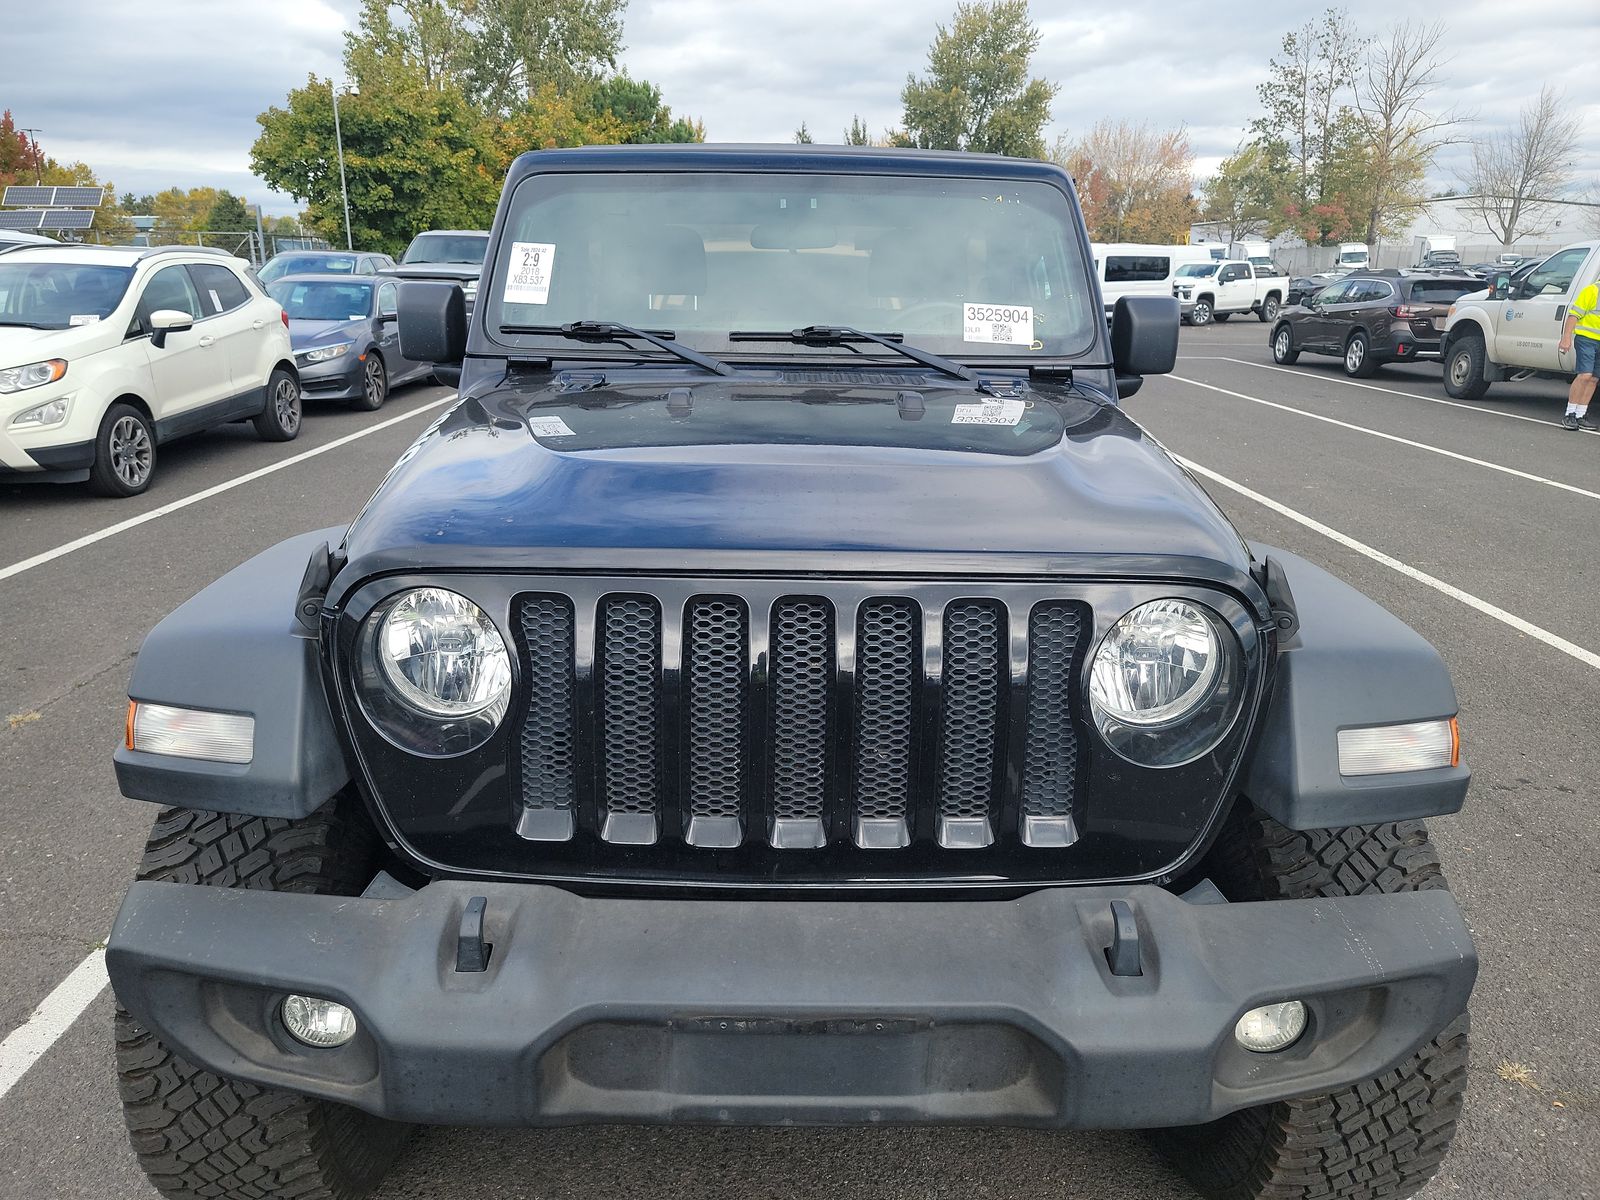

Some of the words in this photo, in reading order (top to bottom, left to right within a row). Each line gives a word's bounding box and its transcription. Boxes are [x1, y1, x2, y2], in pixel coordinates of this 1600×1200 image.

[522, 252, 540, 267] 2:9
[520, 267, 540, 275] 2018
[967, 306, 1029, 324] 3525904
